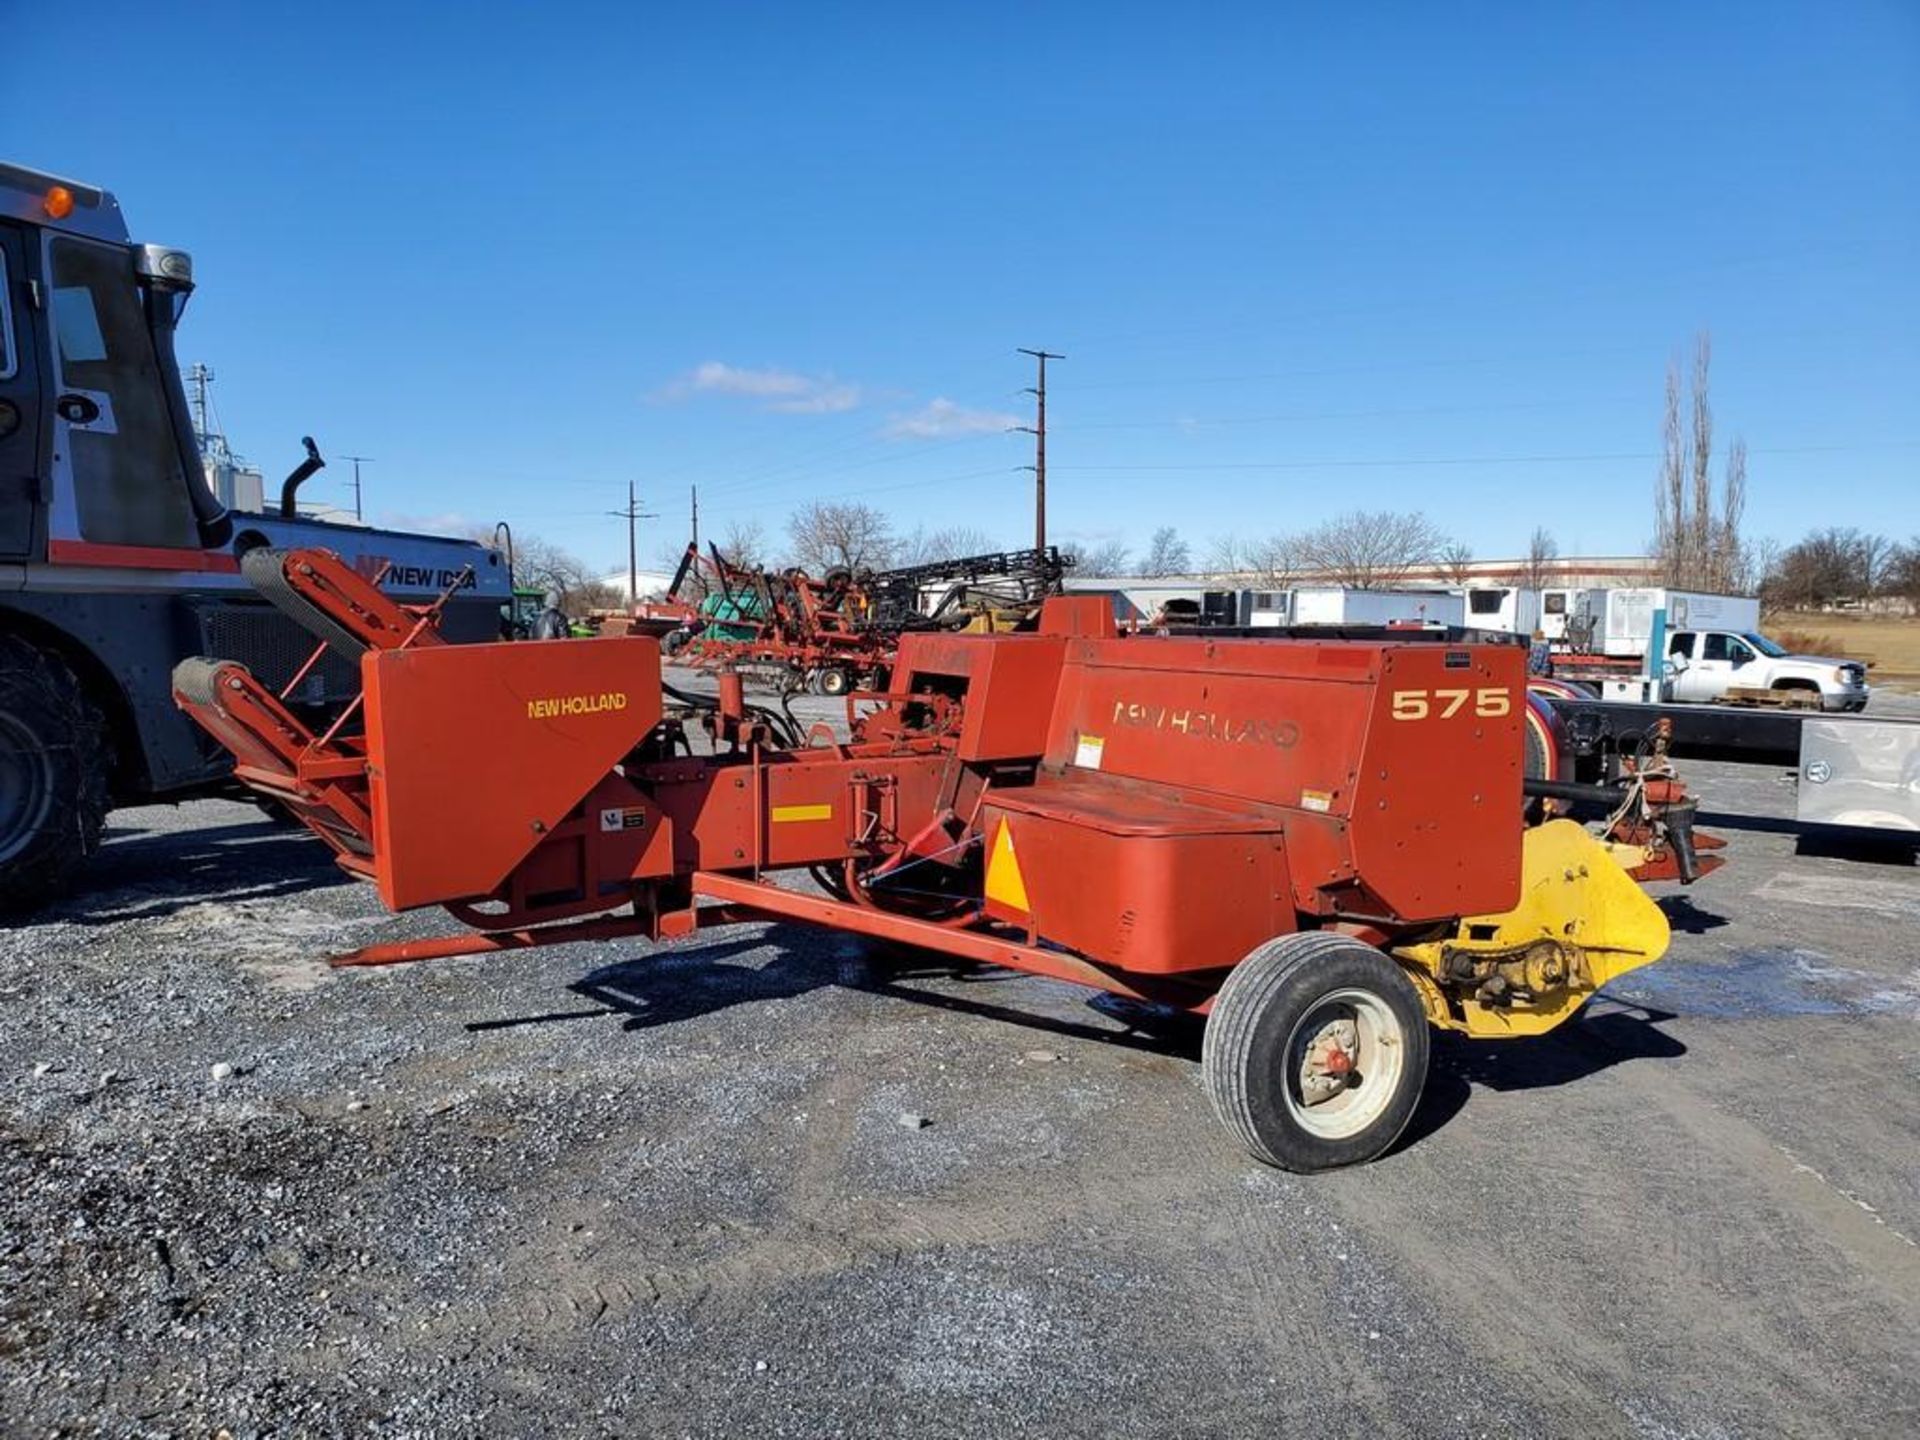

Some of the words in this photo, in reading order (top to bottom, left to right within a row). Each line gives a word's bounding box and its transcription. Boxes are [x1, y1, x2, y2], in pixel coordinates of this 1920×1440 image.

[390, 567, 433, 587] NEW
[528, 699, 560, 719] NEW
[562, 693, 627, 715] HOLLAND
[1392, 688, 1510, 720] 575
